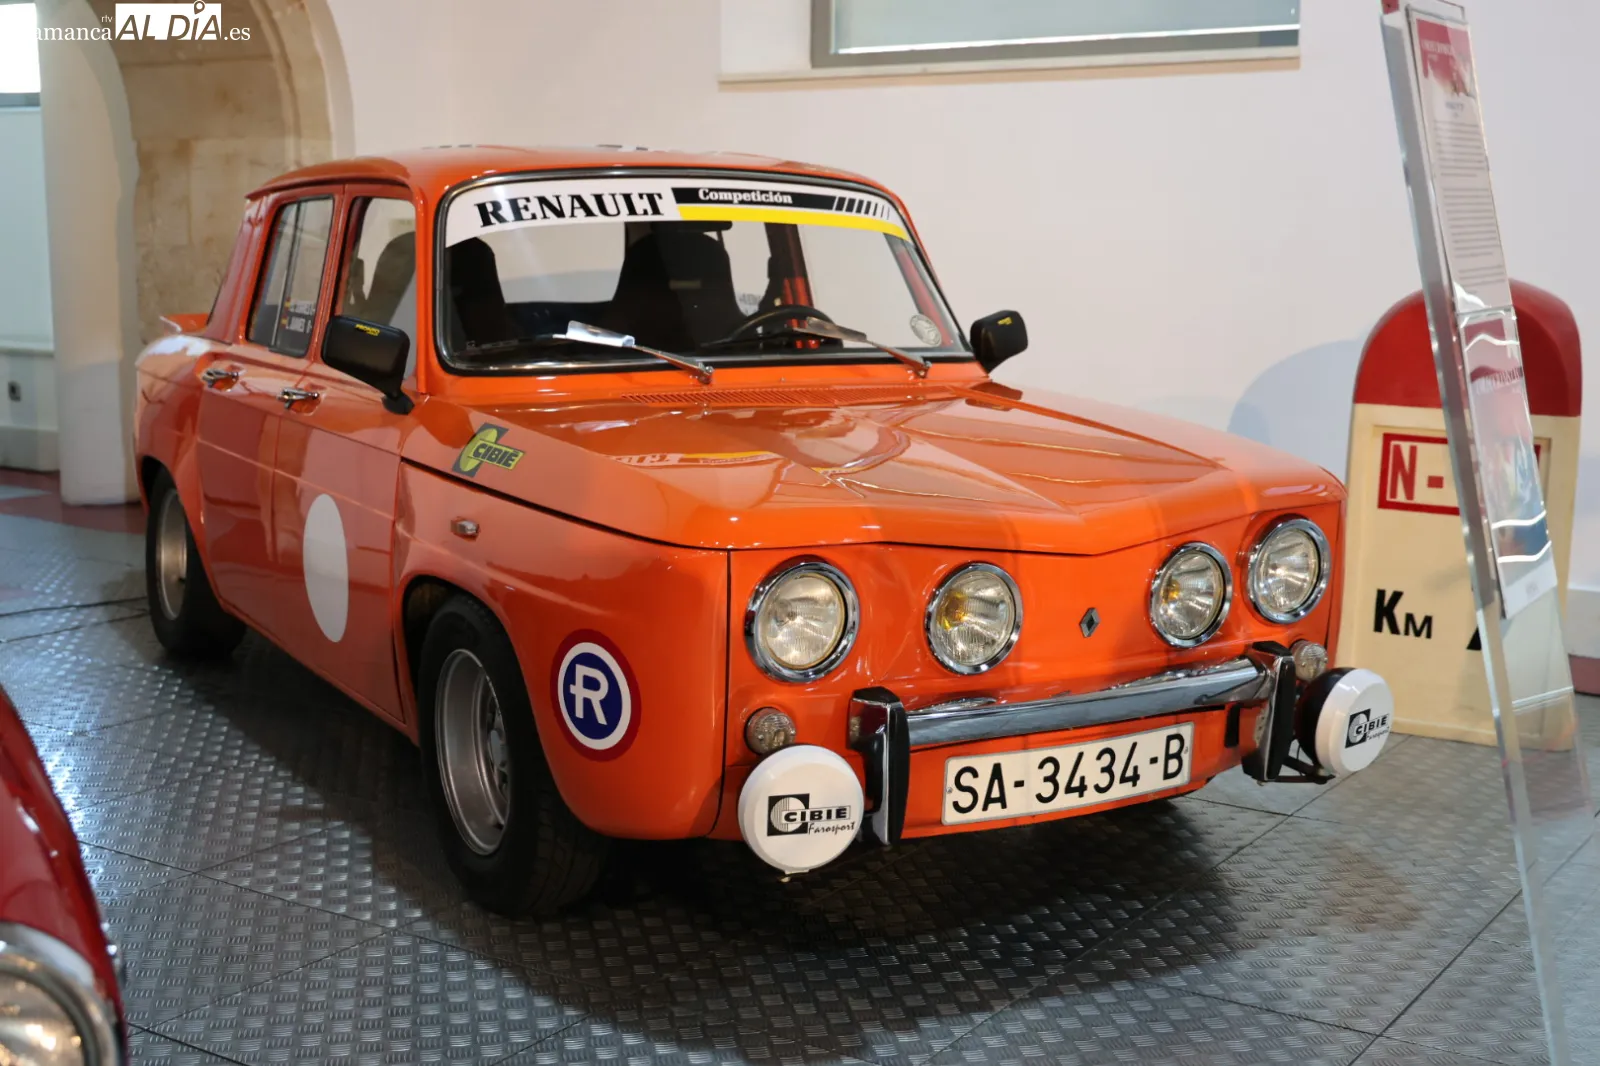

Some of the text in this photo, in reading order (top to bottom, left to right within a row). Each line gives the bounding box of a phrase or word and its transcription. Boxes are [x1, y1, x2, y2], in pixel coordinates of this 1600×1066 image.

[698, 188, 793, 205] Competición
[474, 192, 665, 228] RENAULT
[808, 822, 856, 836] Farosport
